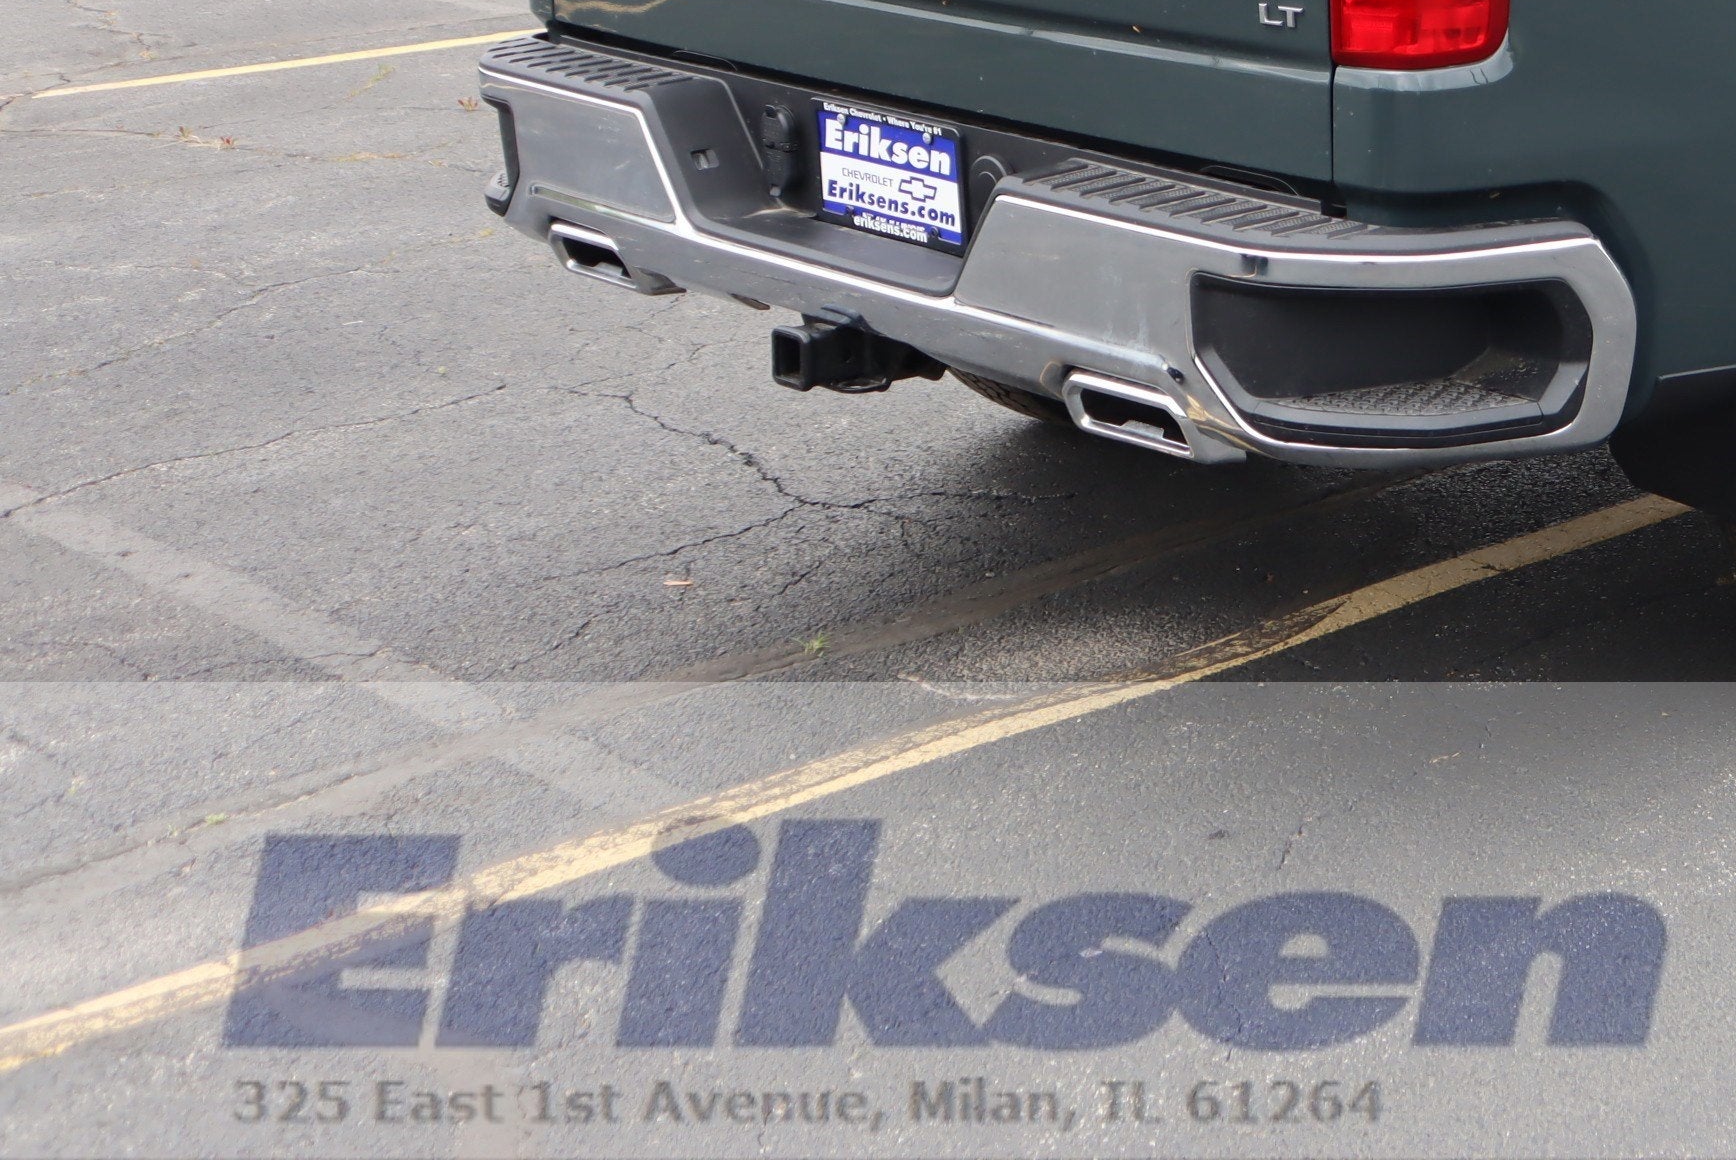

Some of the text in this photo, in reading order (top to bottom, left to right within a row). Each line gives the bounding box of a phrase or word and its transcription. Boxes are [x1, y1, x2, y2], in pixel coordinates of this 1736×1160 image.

[1258, 2, 1304, 28] LT
[825, 118, 950, 175] Eriksen
[841, 167, 894, 187] CHEVROLET
[827, 178, 955, 227] Eriksens.com
[852, 214, 928, 243] eriksens.com
